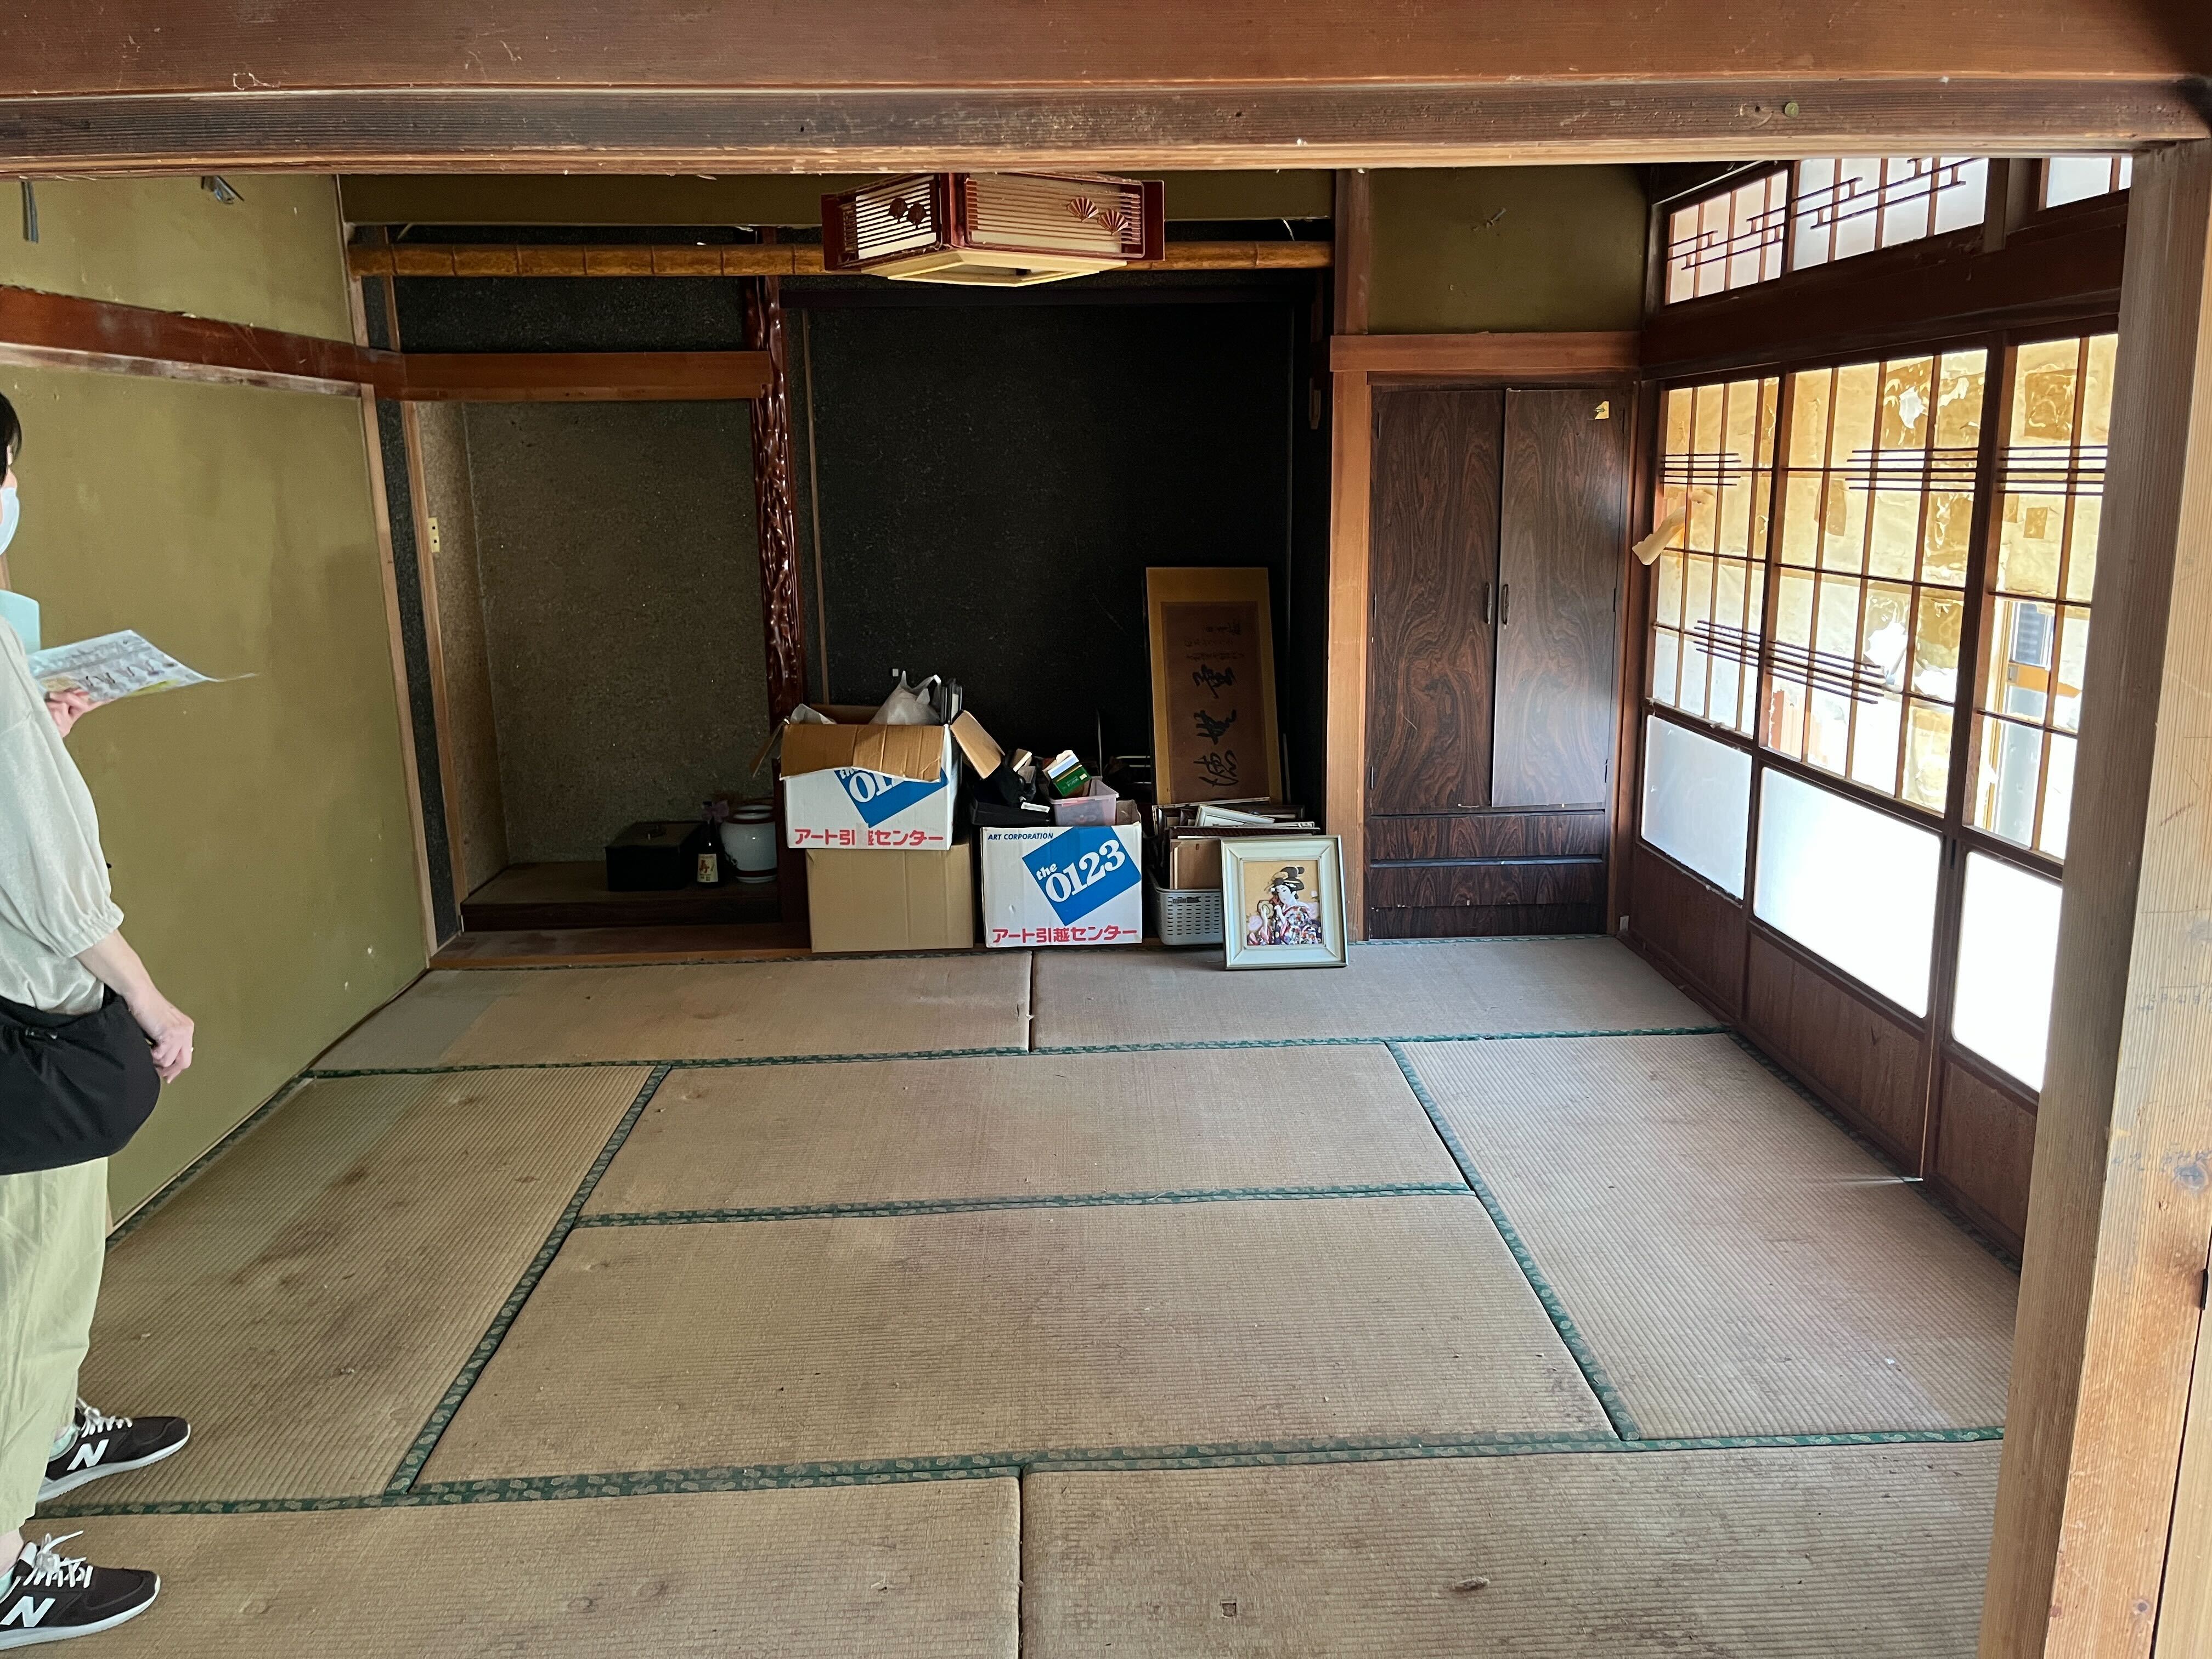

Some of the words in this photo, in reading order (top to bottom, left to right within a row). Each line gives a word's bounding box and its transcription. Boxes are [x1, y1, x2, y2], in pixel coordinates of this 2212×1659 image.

[1036, 863, 1057, 880] the
[1045, 839, 1125, 902] 0123
[992, 926, 1137, 943] アート引越センター
[67, 1439, 109, 1470] N
[0, 1596, 55, 1627] N
